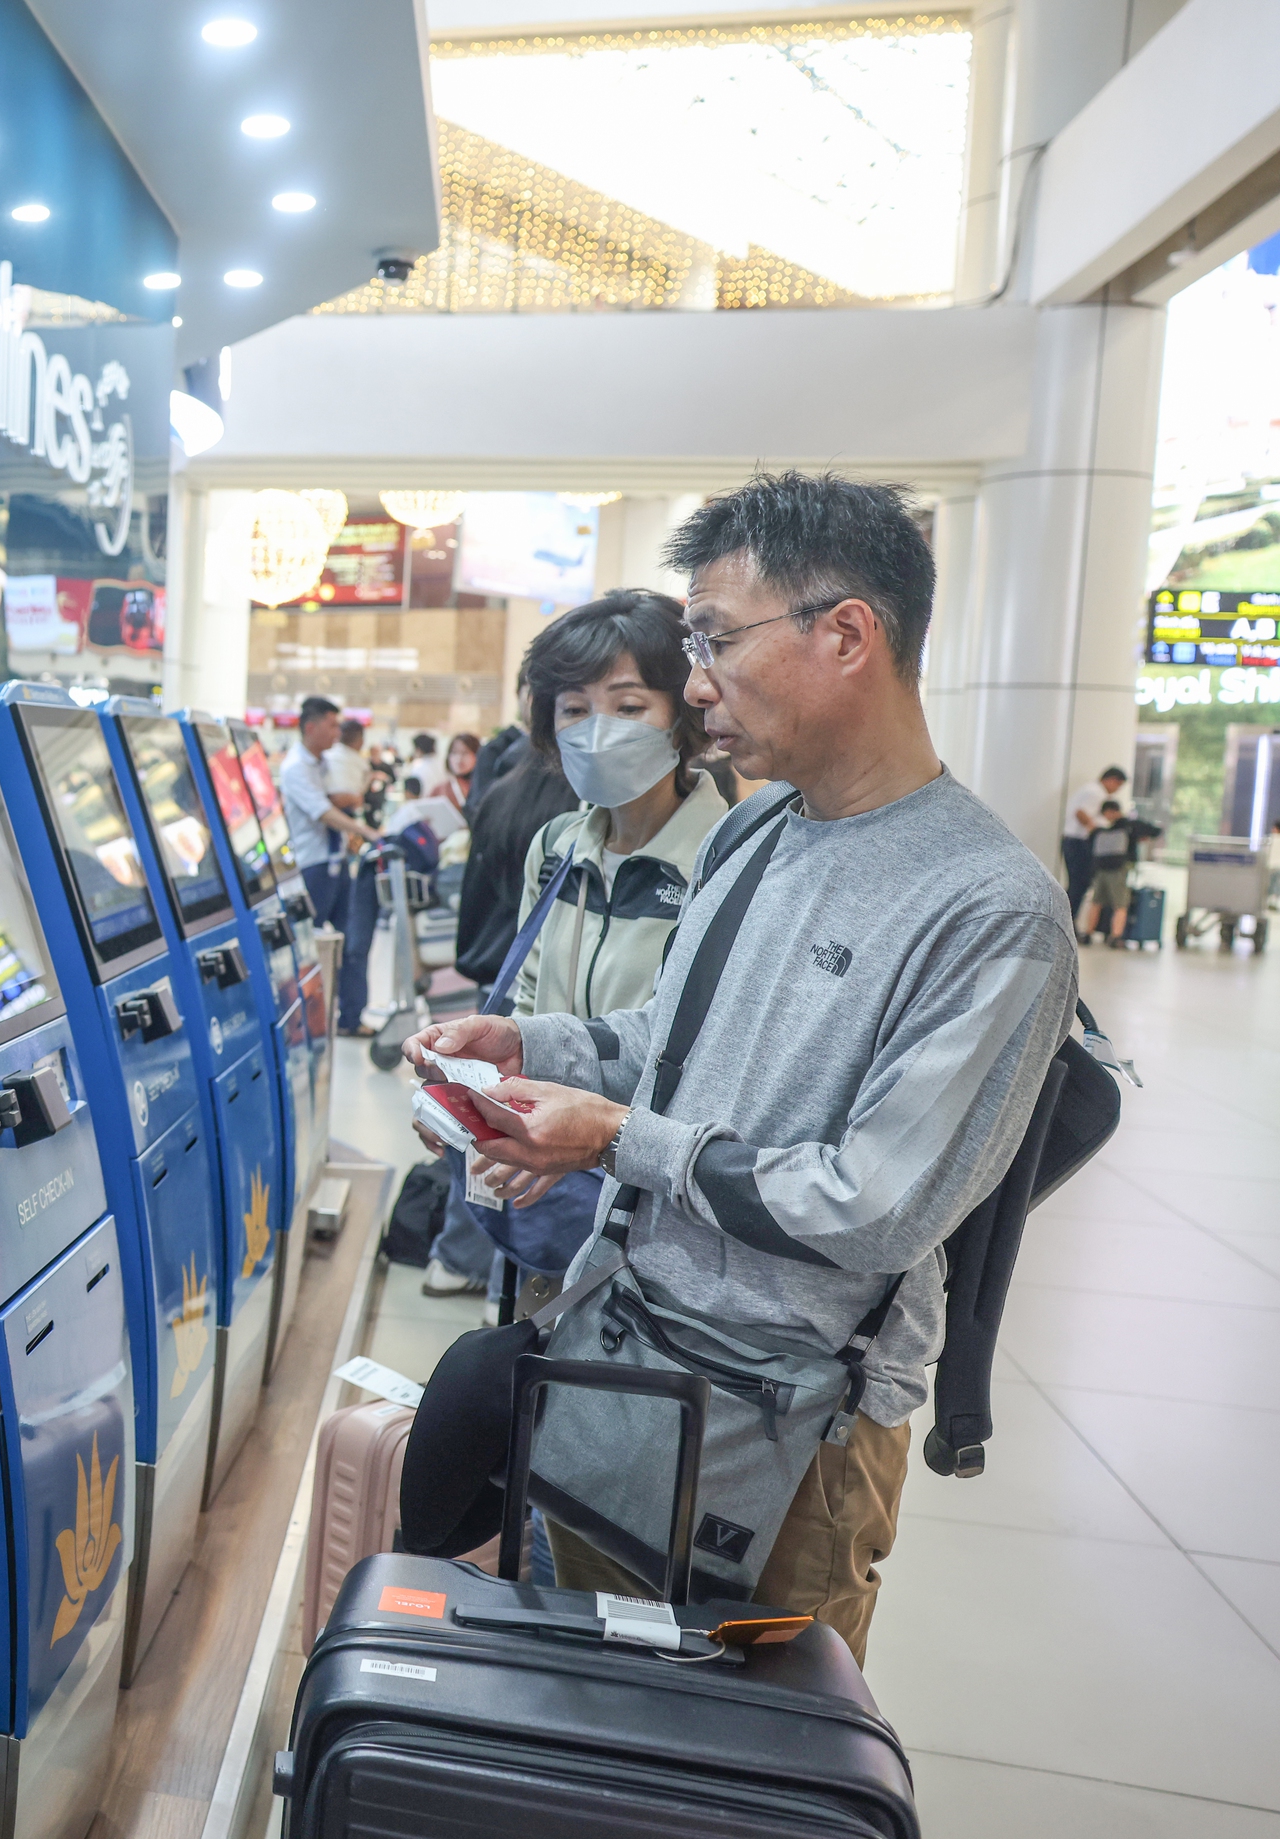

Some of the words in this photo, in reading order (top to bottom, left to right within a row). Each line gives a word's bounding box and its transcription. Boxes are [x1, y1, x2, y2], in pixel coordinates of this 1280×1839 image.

[810, 943, 839, 963] NORTH
[827, 940, 845, 955] THE
[812, 956, 834, 972] FACE
[18, 1192, 38, 1225] SELF
[38, 1166, 75, 1209] CHECK-IN
[394, 1600, 431, 1610] LOJEL
